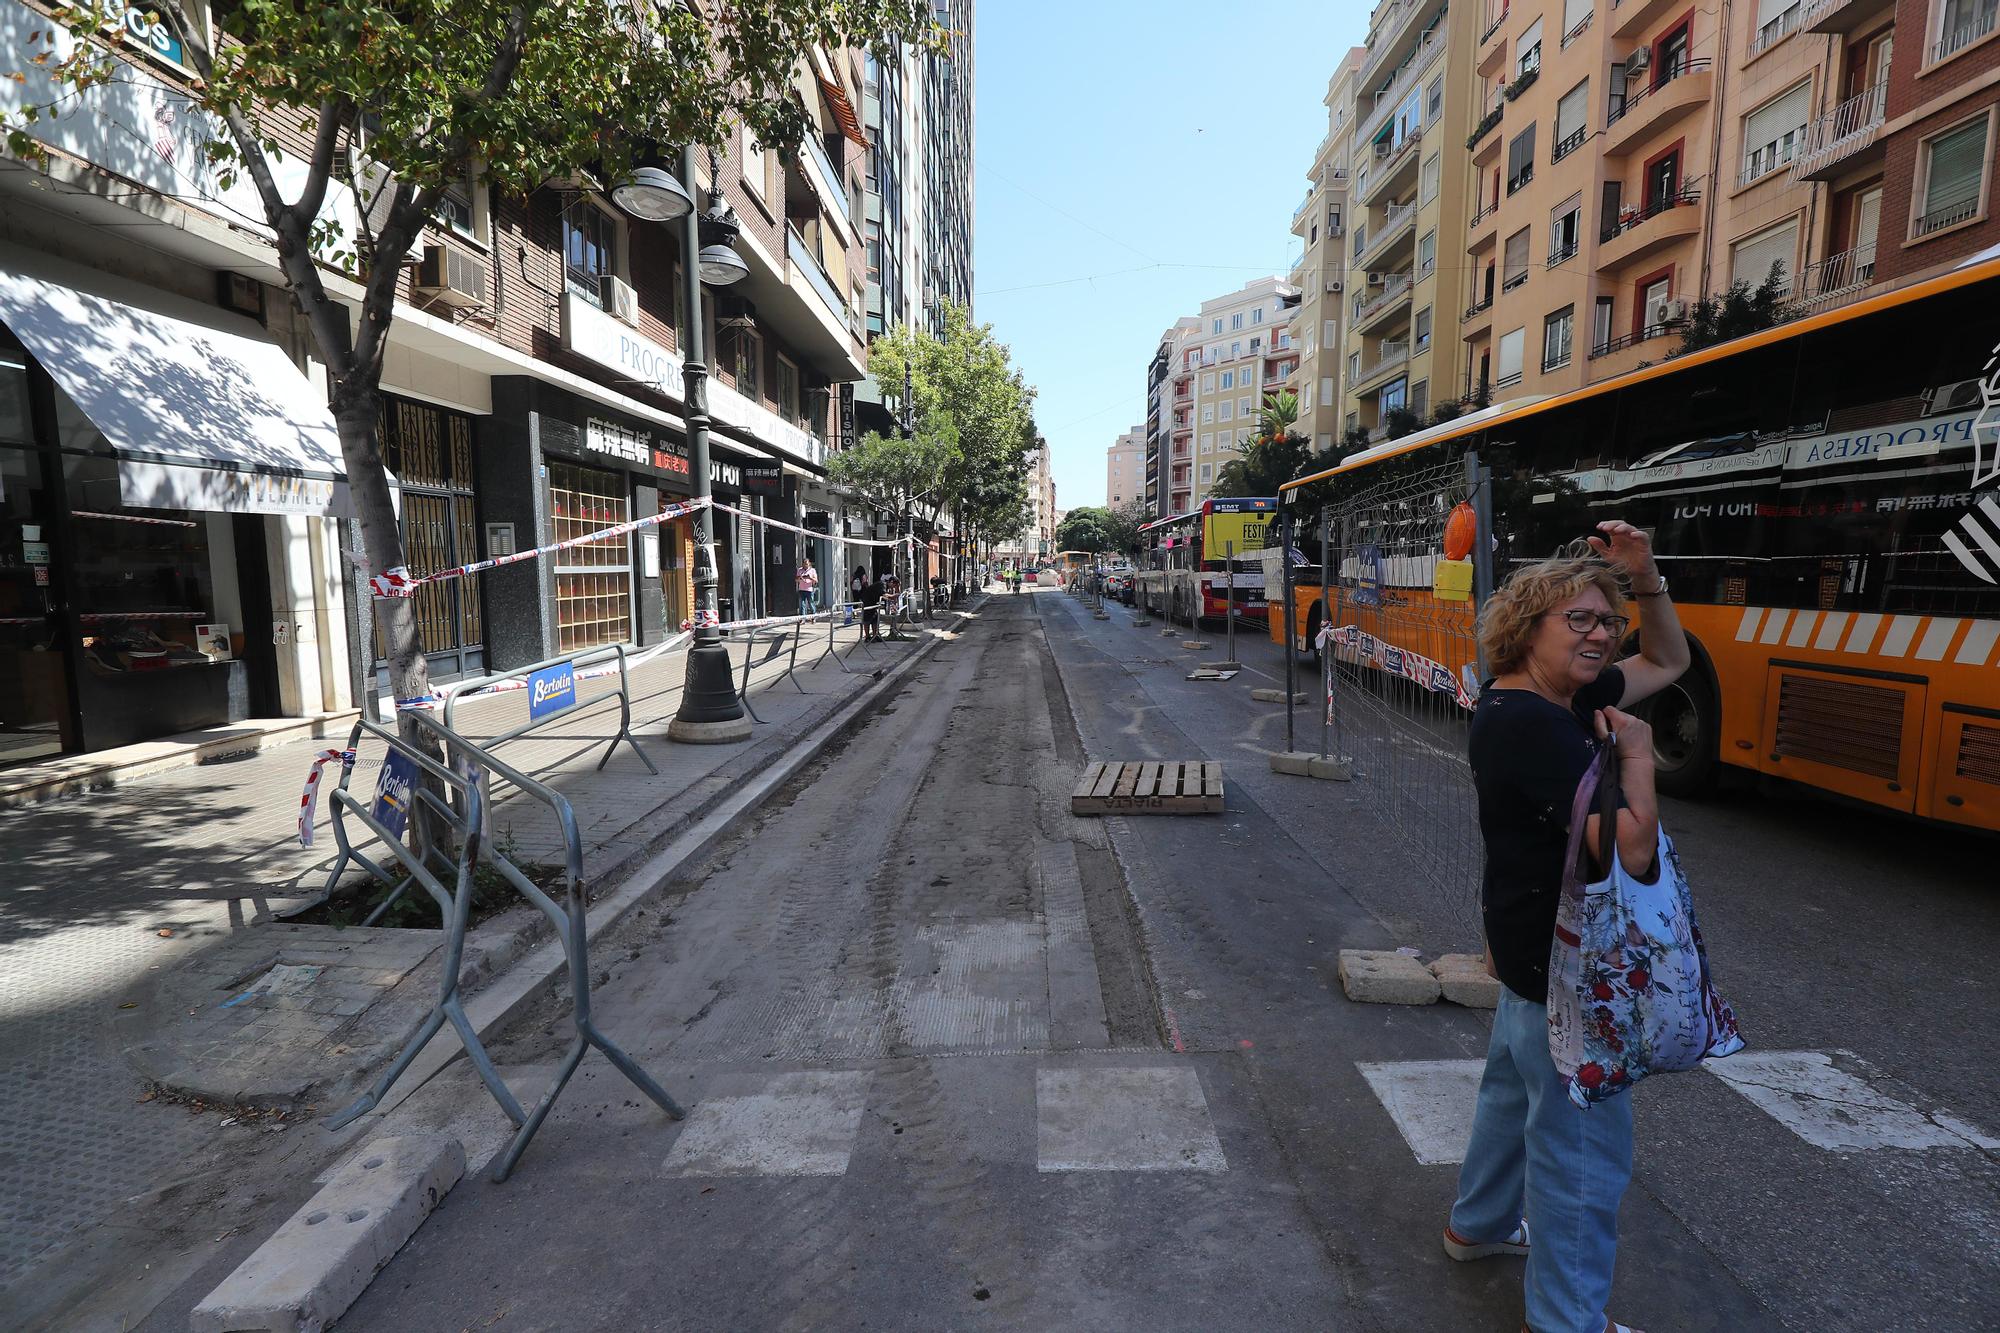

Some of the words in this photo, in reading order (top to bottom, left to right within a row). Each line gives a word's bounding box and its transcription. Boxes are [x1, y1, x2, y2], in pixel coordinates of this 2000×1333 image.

[621, 335, 684, 392] PROGRE
[842, 388, 853, 446] TURISMO
[659, 439, 676, 453] SPICY
[709, 459, 721, 482] OT
[722, 462, 740, 487] POT
[1243, 524, 1267, 539] FESTI
[387, 587, 399, 598] NO
